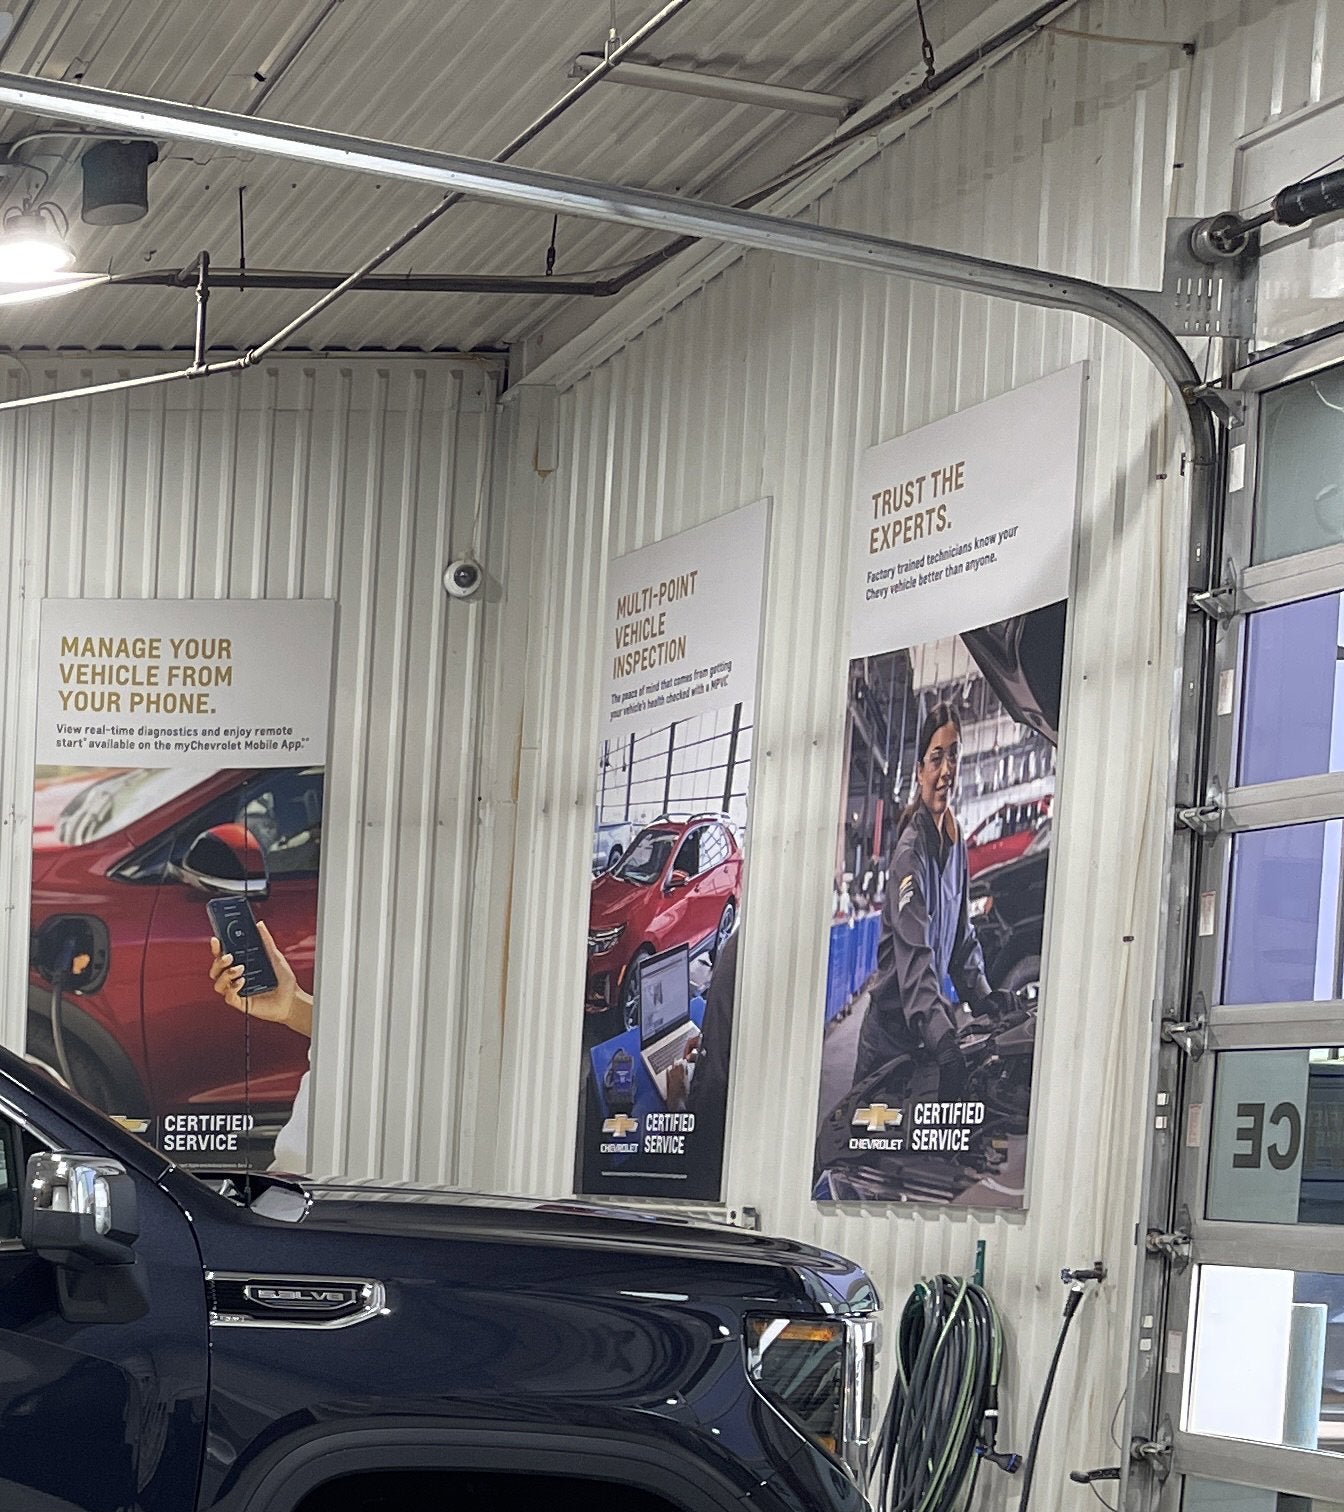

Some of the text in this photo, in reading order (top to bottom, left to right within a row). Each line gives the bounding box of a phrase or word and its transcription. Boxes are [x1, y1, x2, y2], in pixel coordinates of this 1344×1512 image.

[872, 461, 965, 520] TRUST THE
[869, 503, 952, 554] EXPERTS.
[867, 526, 1019, 583] Factory trained technicians know your
[866, 553, 997, 600] Chevy vehicle better than anyone.
[616, 570, 698, 620] MULTI-POINT
[615, 612, 666, 650] VEHICLE
[61, 636, 232, 660] MANAGE YOUR
[612, 635, 687, 680] INSPECTION
[59, 663, 232, 687] VEHICLE FROM
[58, 690, 216, 714] YOUR PHONE.
[56, 723, 293, 739] View real-time diagnostics and enjoy remote
[89, 739, 135, 749] available
[138, 742, 151, 750] on
[154, 739, 171, 750] the
[174, 740, 241, 752] myChevrolet
[244, 740, 278, 750] Mobile
[164, 1115, 254, 1132] CERTIFIED
[645, 1113, 695, 1132] CERTIFIED
[914, 1102, 985, 1125] CERTIFIED
[163, 1134, 237, 1151] SERVICE
[600, 1143, 639, 1153] CHEVROLET
[644, 1135, 685, 1154] SERVICE
[849, 1138, 903, 1150] CHEVROLET
[911, 1129, 970, 1151] SERVICE
